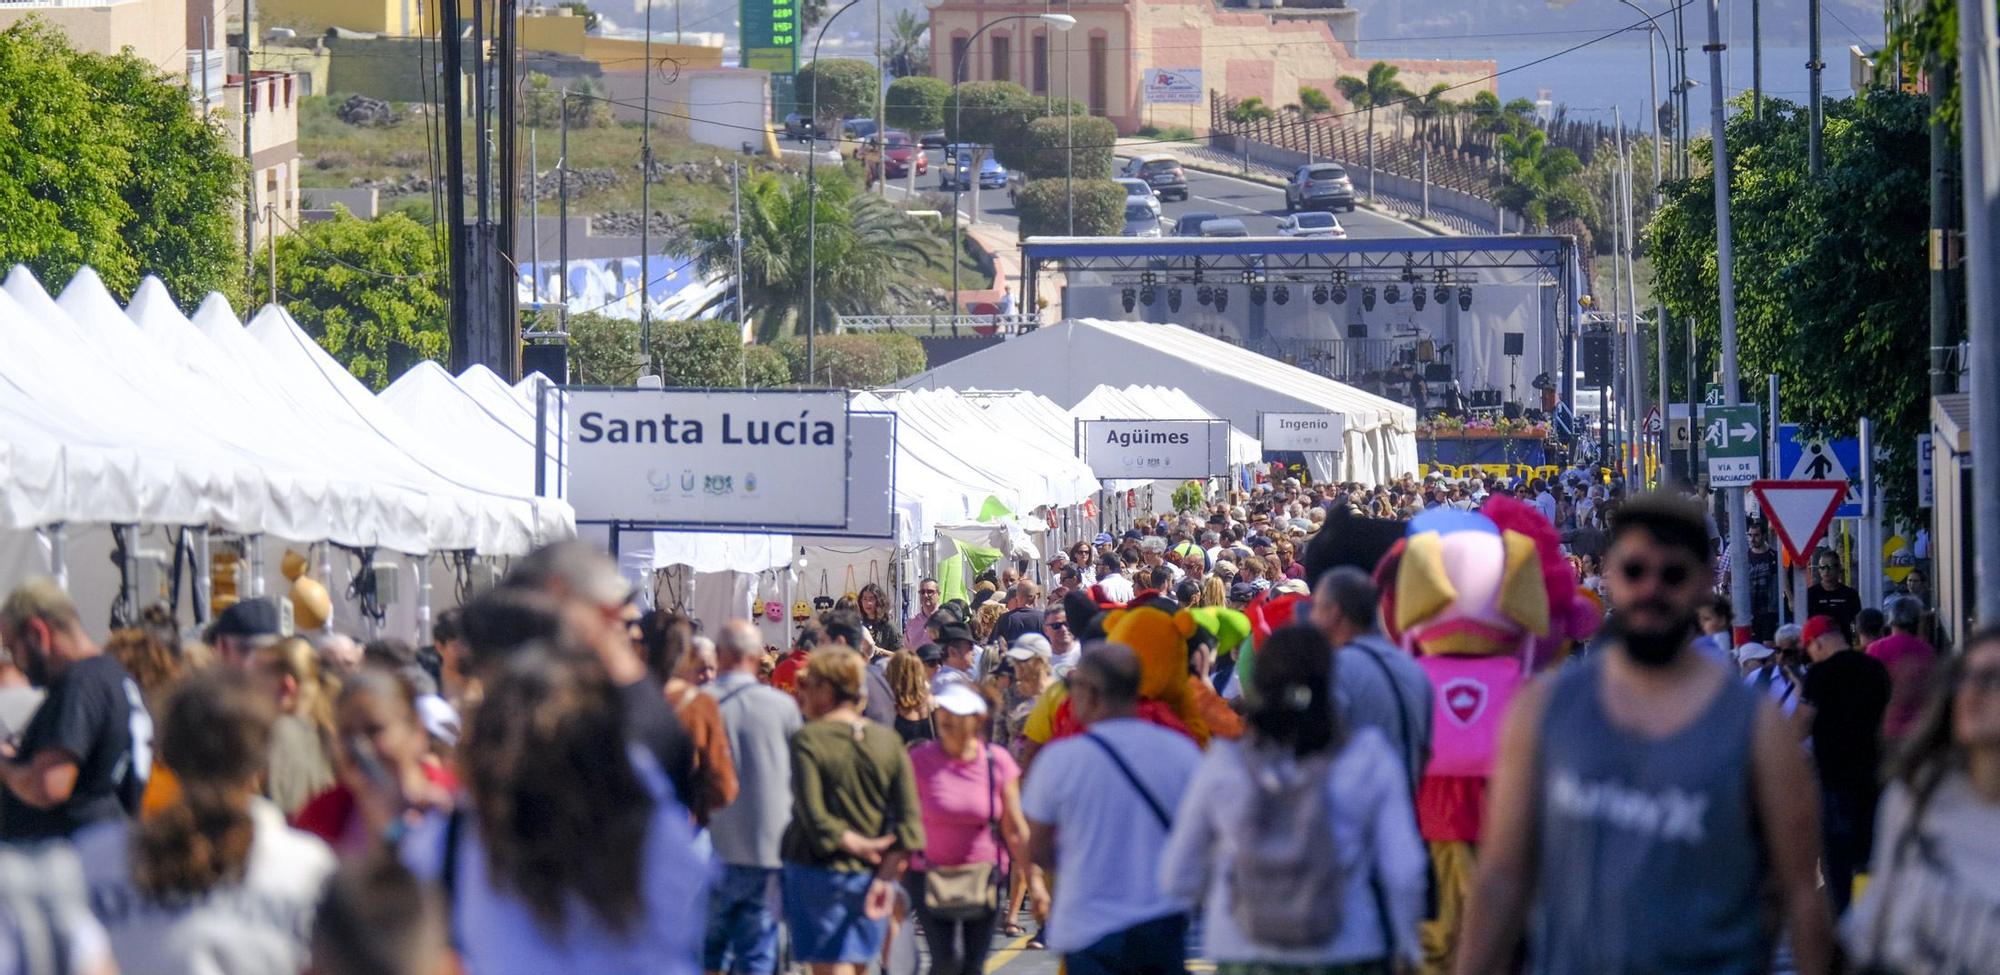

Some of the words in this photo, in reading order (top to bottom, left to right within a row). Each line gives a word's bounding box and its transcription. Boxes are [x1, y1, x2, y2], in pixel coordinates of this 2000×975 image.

[579, 411, 703, 444] Santa
[722, 410, 834, 446] Lucía
[1280, 419, 1328, 431] Ingenio
[1107, 429, 1189, 447] Agüimes
[1738, 463, 1751, 471] DE
